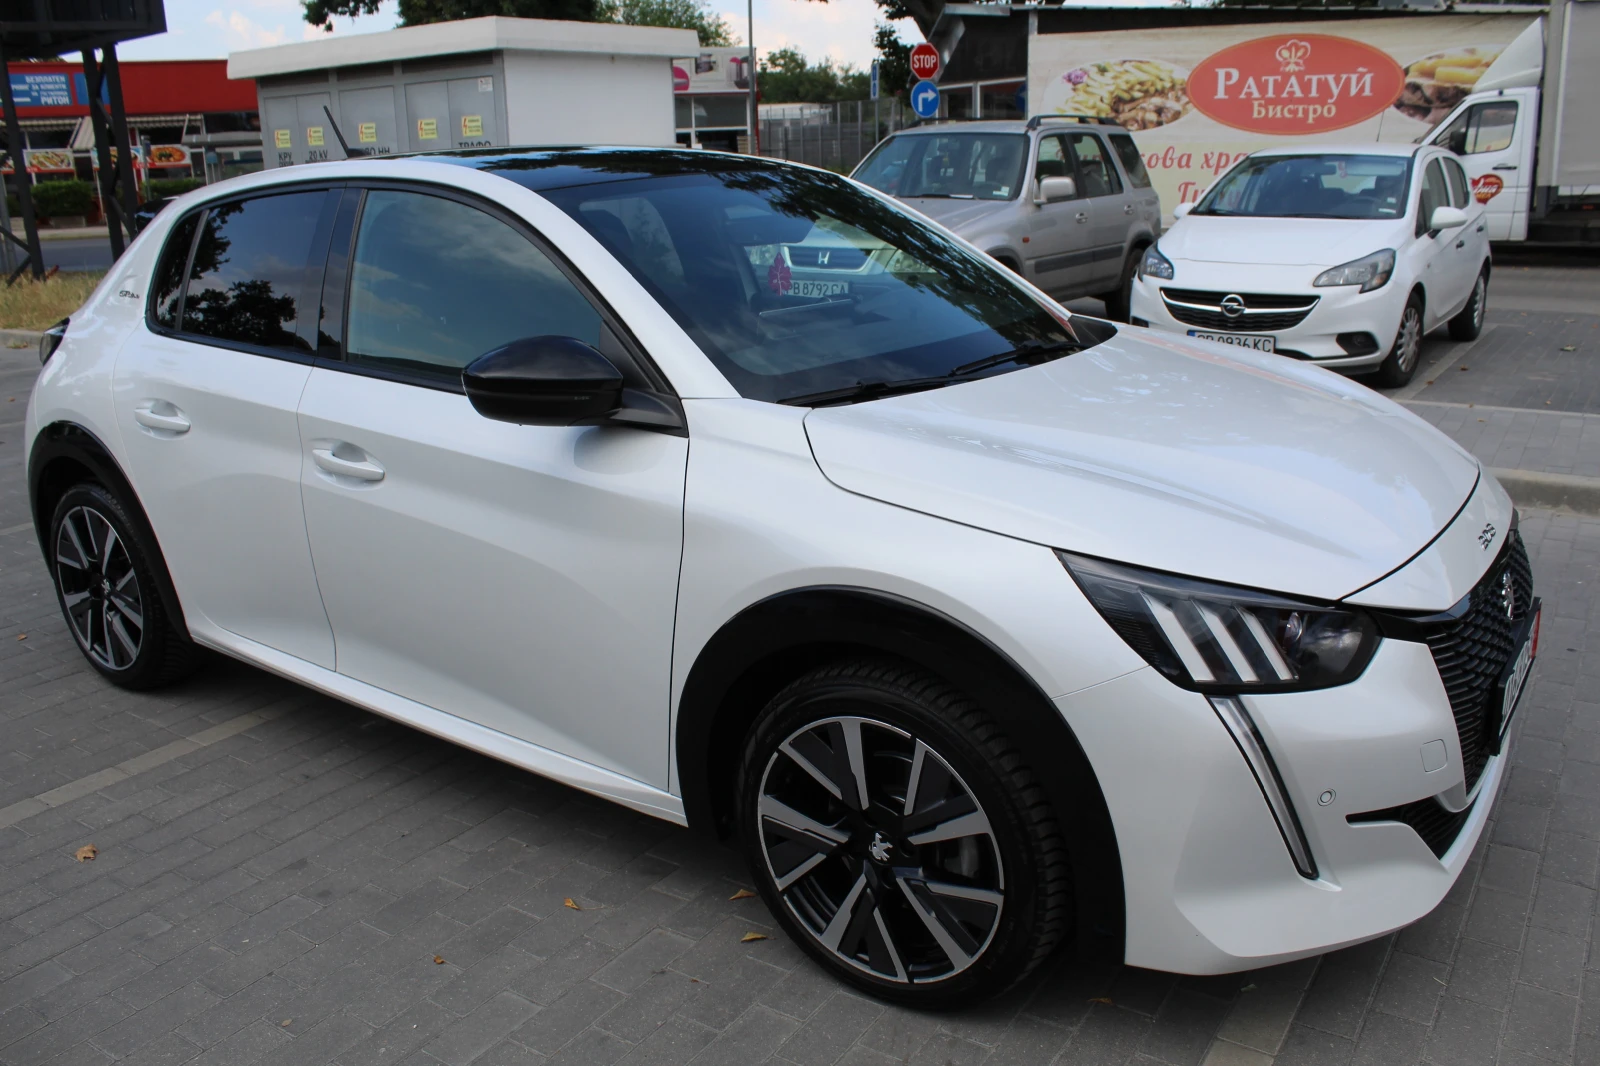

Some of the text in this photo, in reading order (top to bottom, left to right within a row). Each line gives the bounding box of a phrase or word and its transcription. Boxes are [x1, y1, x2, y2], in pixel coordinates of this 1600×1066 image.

[913, 54, 937, 69] STOP
[1251, 100, 1337, 125] Бистро
[802, 282, 830, 297] 8792
[1252, 337, 1272, 353] KC
